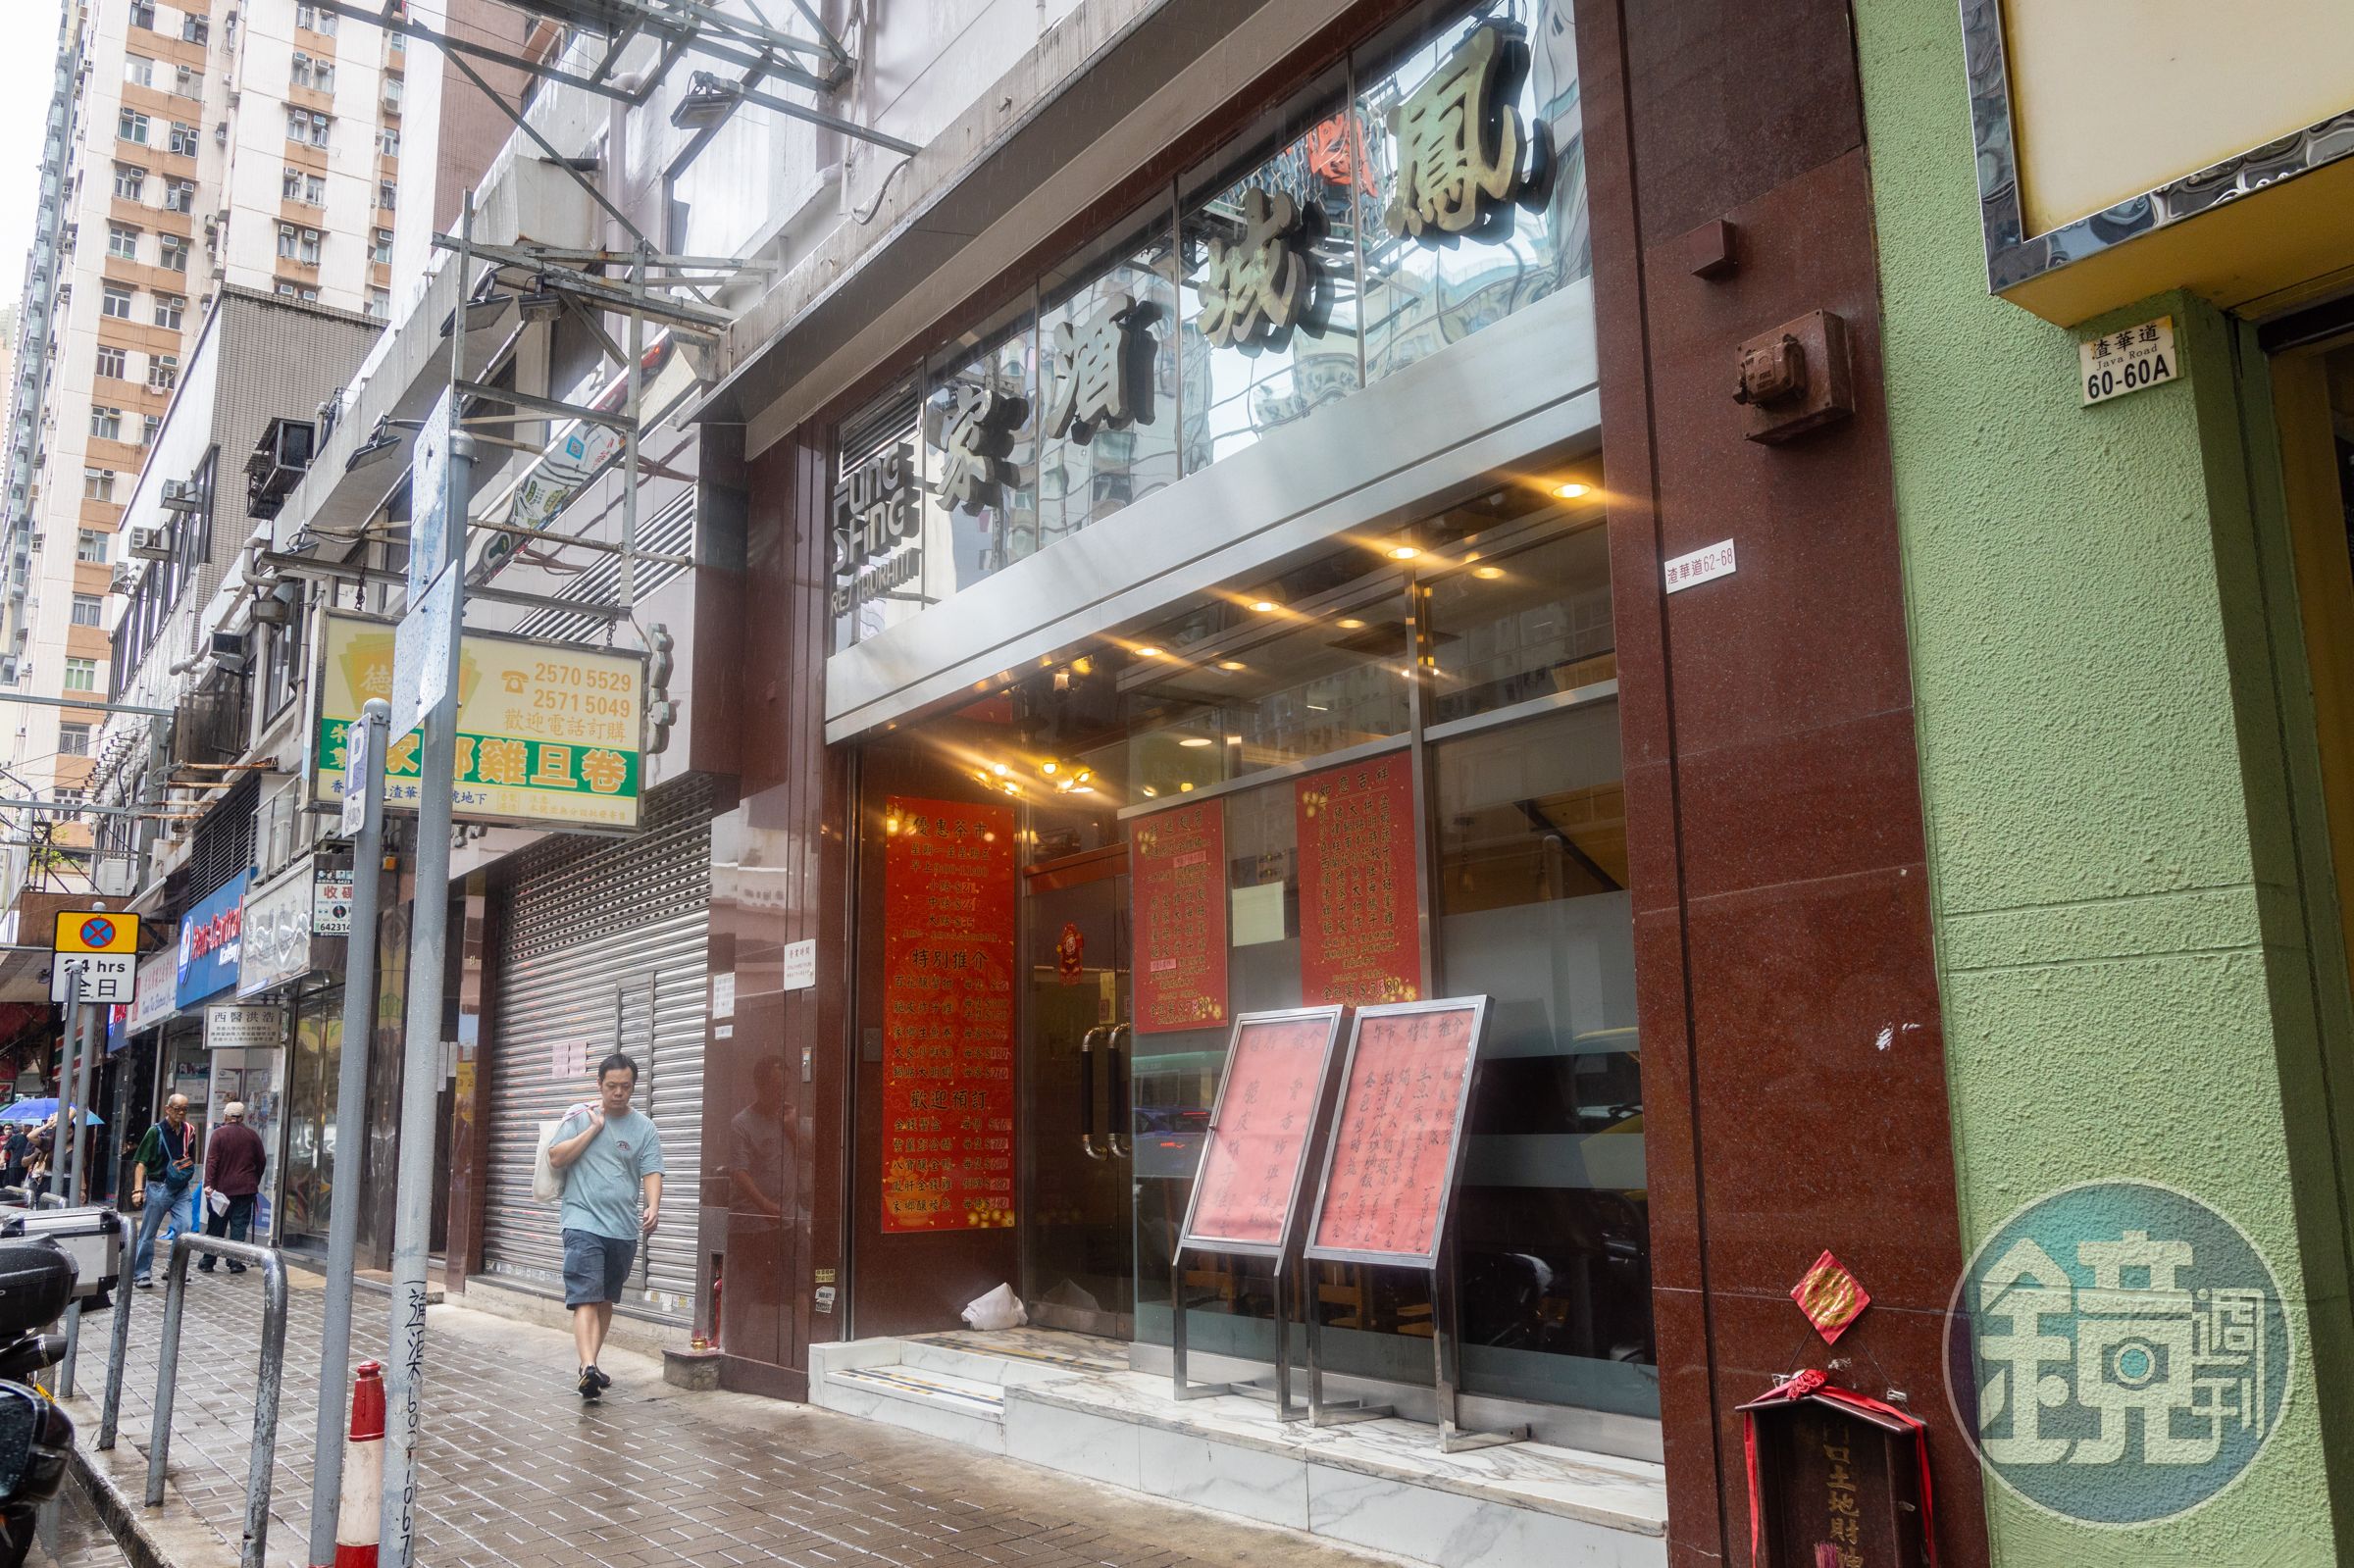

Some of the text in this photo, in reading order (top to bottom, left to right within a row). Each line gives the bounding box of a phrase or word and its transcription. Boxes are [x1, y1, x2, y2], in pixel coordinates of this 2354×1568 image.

[2096, 344, 2158, 371] Java Road
[2087, 354, 2171, 399] 60-60A
[535, 662, 633, 692] 2570 5529
[533, 689, 631, 719] 2571 5049
[503, 707, 627, 744] 歡迎電話訂購
[347, 727, 364, 790] P
[1319, 767, 1389, 796] 如意吉祥
[913, 816, 988, 838] 優惠茶市
[96, 960, 126, 973] hrs
[911, 949, 989, 970] 特別推介
[214, 1010, 275, 1023] 西醫洪浩
[909, 1088, 988, 1110] 歡迎預訂
